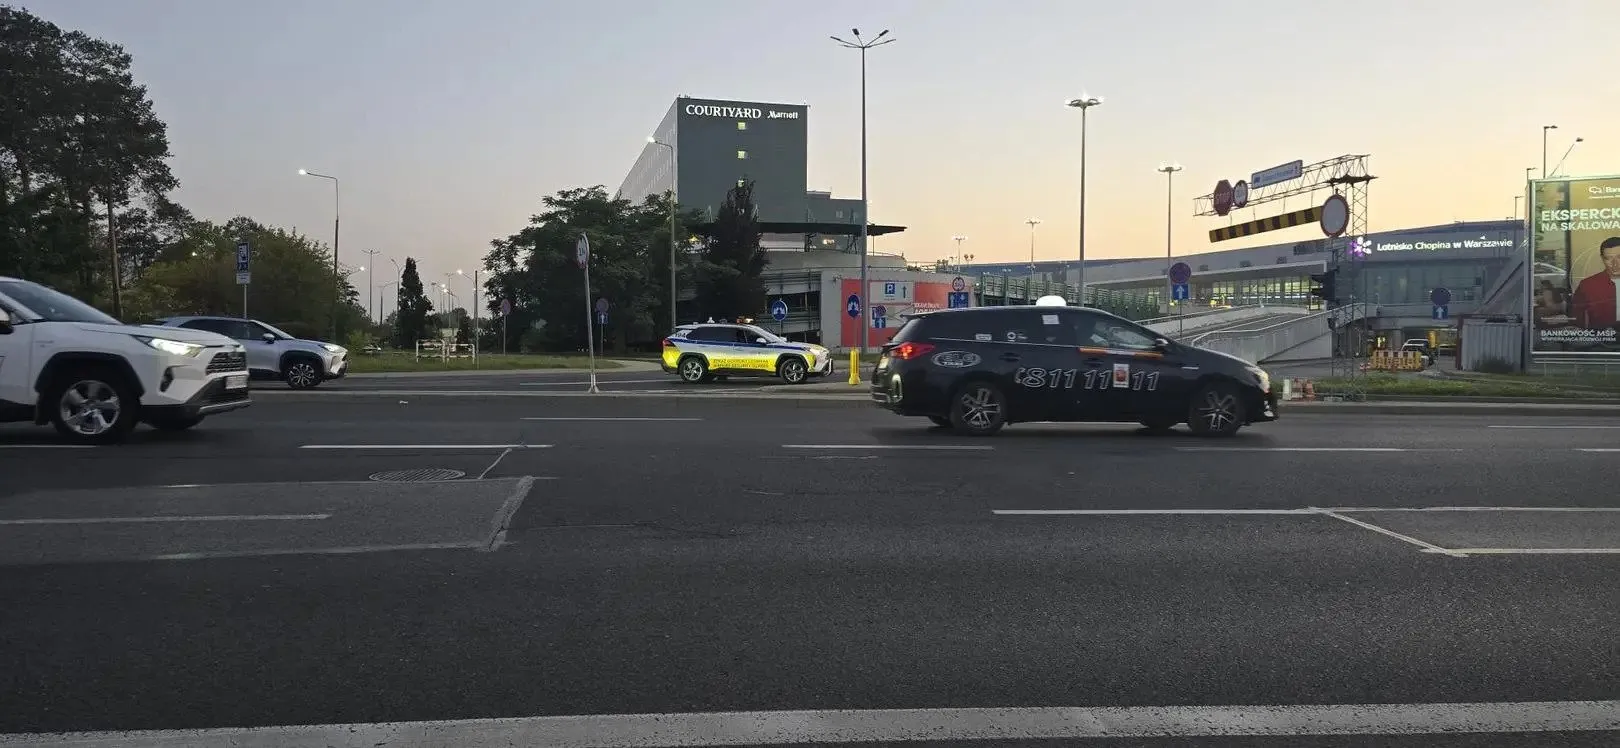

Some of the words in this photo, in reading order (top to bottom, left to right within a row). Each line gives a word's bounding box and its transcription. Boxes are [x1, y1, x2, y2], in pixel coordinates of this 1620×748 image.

[685, 104, 761, 119] COURTYARD
[767, 110, 798, 119] Marriott
[1541, 222, 1558, 231] NA
[1377, 242, 1413, 251] Lotnisko
[1415, 241, 1451, 250] Chopina
[1453, 241, 1462, 249] w
[1464, 238, 1513, 249] Warszawie
[1541, 328, 1595, 336] BANKOWOŚĆ
[1021, 367, 1077, 389] 811
[1083, 369, 1113, 390] 11
[1132, 371, 1160, 391] 11
